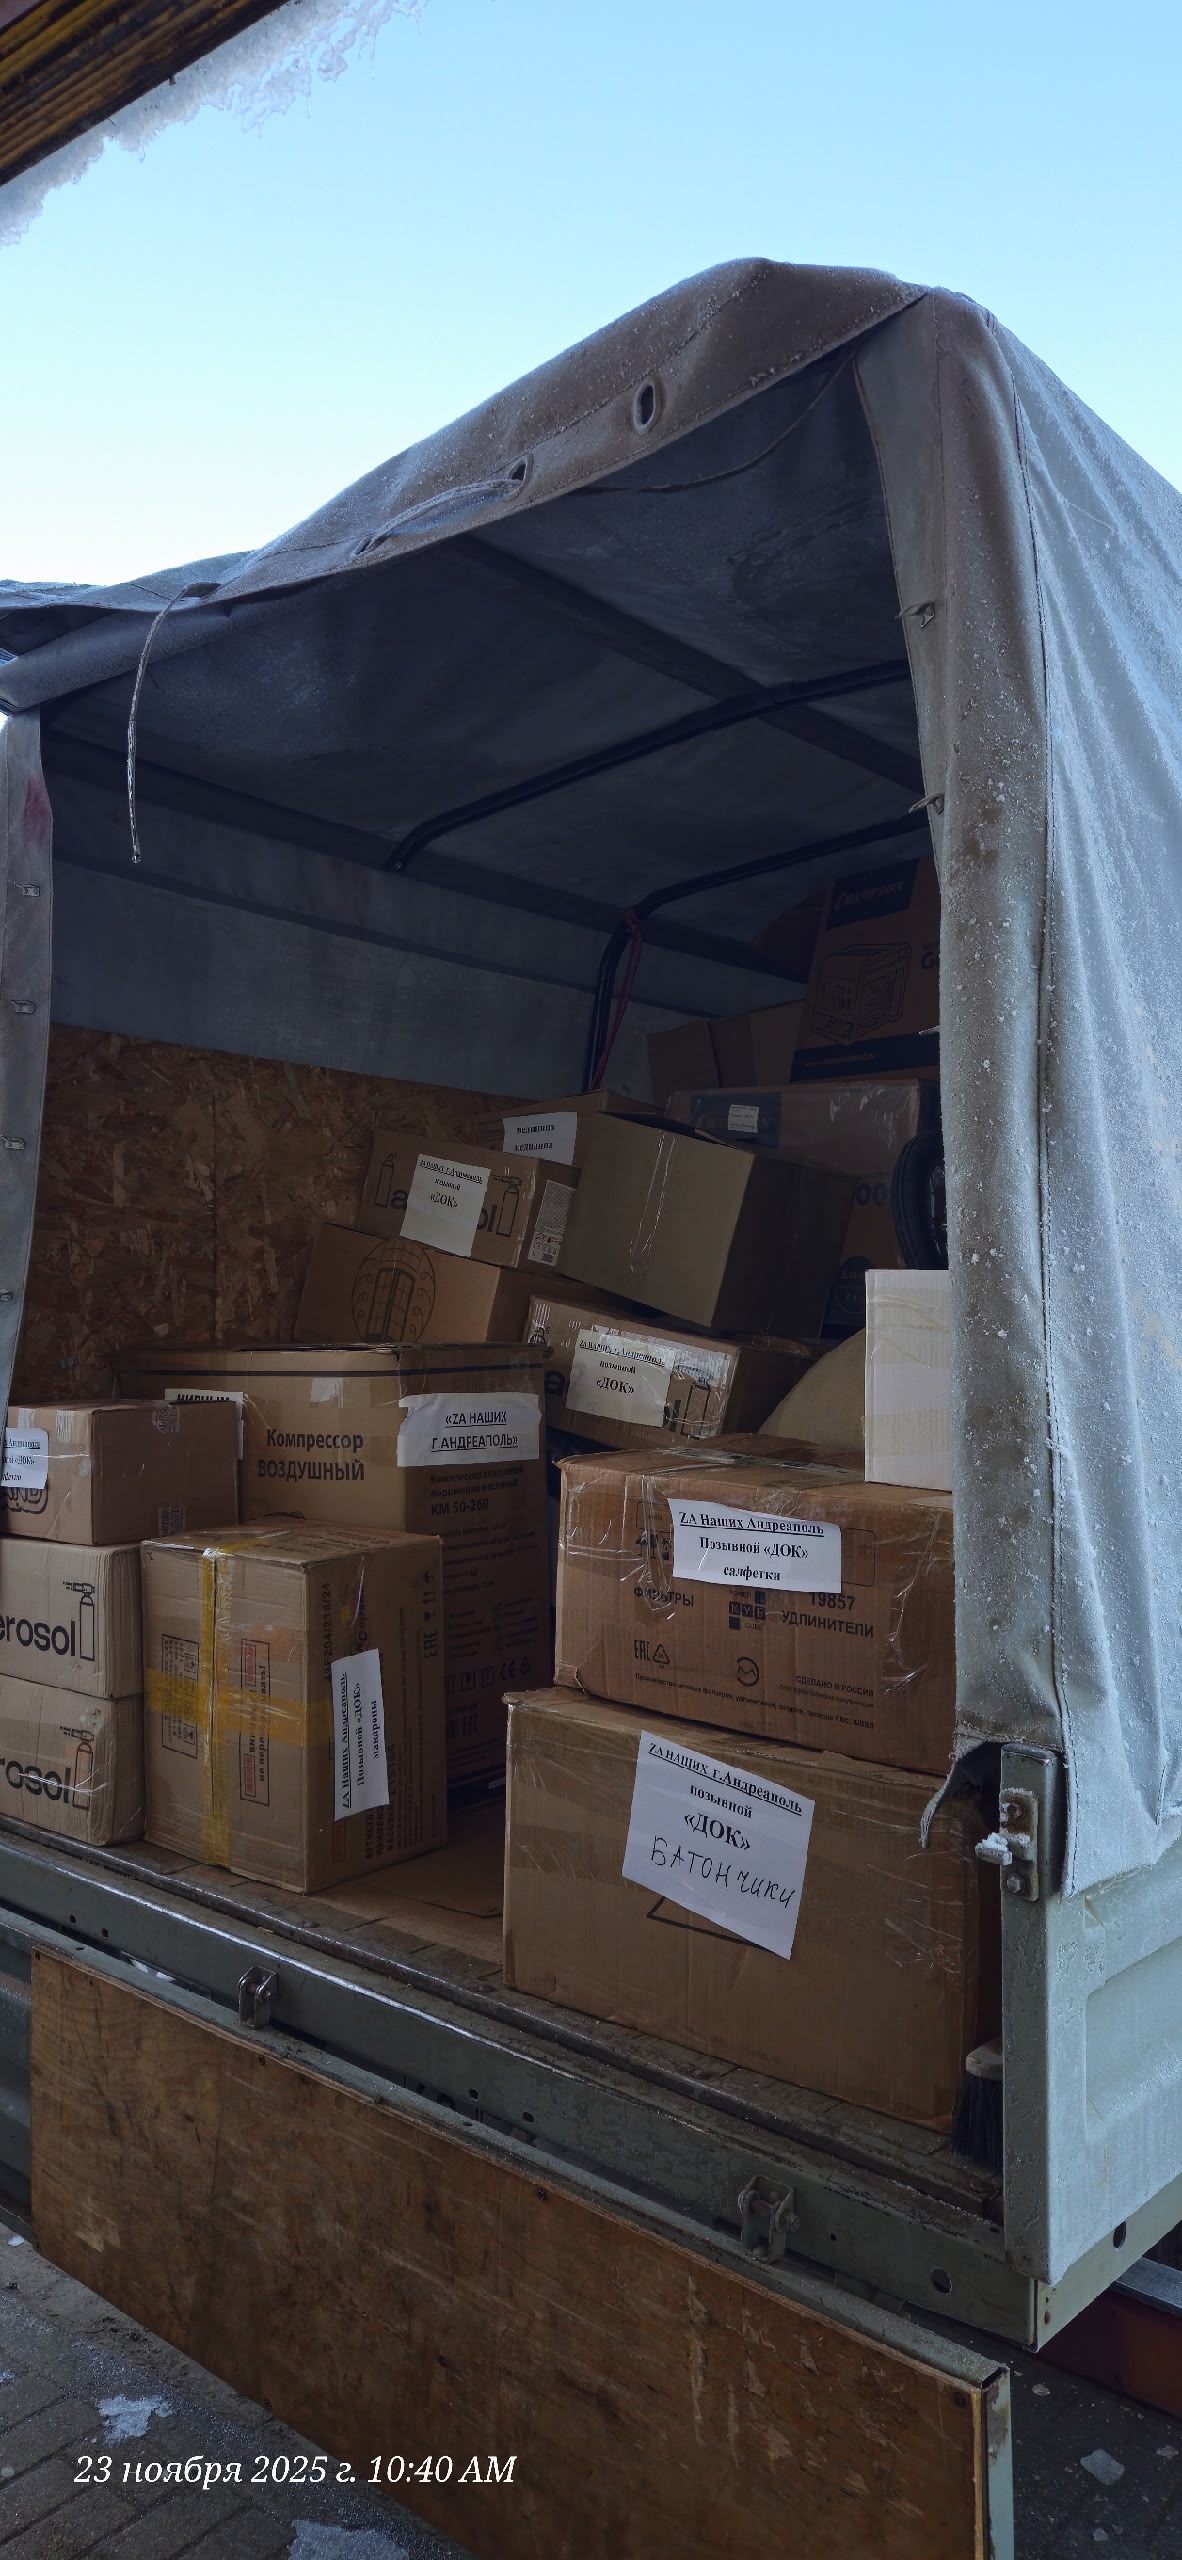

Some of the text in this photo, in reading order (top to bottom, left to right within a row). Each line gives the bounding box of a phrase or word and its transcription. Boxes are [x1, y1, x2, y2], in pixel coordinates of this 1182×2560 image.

[596, 1376, 635, 1395] «ДОК»
[469, 1411, 507, 1425] НАШИХ
[266, 1428, 364, 1452] Компрессор
[258, 1459, 365, 1482] ВОЗДУШНЫЙ
[453, 1499, 489, 1513] 50-260
[700, 1513, 744, 1529] Наших
[747, 1516, 825, 1535] Андреаполь
[699, 1537, 809, 1560] Позывной «ДОК»
[723, 1565, 781, 1582] салфетки
[782, 1610, 874, 1639] УДЛИНИТЕЛИ
[795, 1675, 833, 1689] СДЕЛАНО
[841, 1684, 874, 1698] РОССИИ
[353, 1683, 363, 1724] «ДОК»
[371, 1700, 381, 1760] макароны
[666, 1748, 709, 1775] НАШИХ
[713, 1769, 803, 1814] г.Андреаполь
[690, 1783, 753, 1819] позывной
[683, 1812, 751, 1852] «ДОК»
